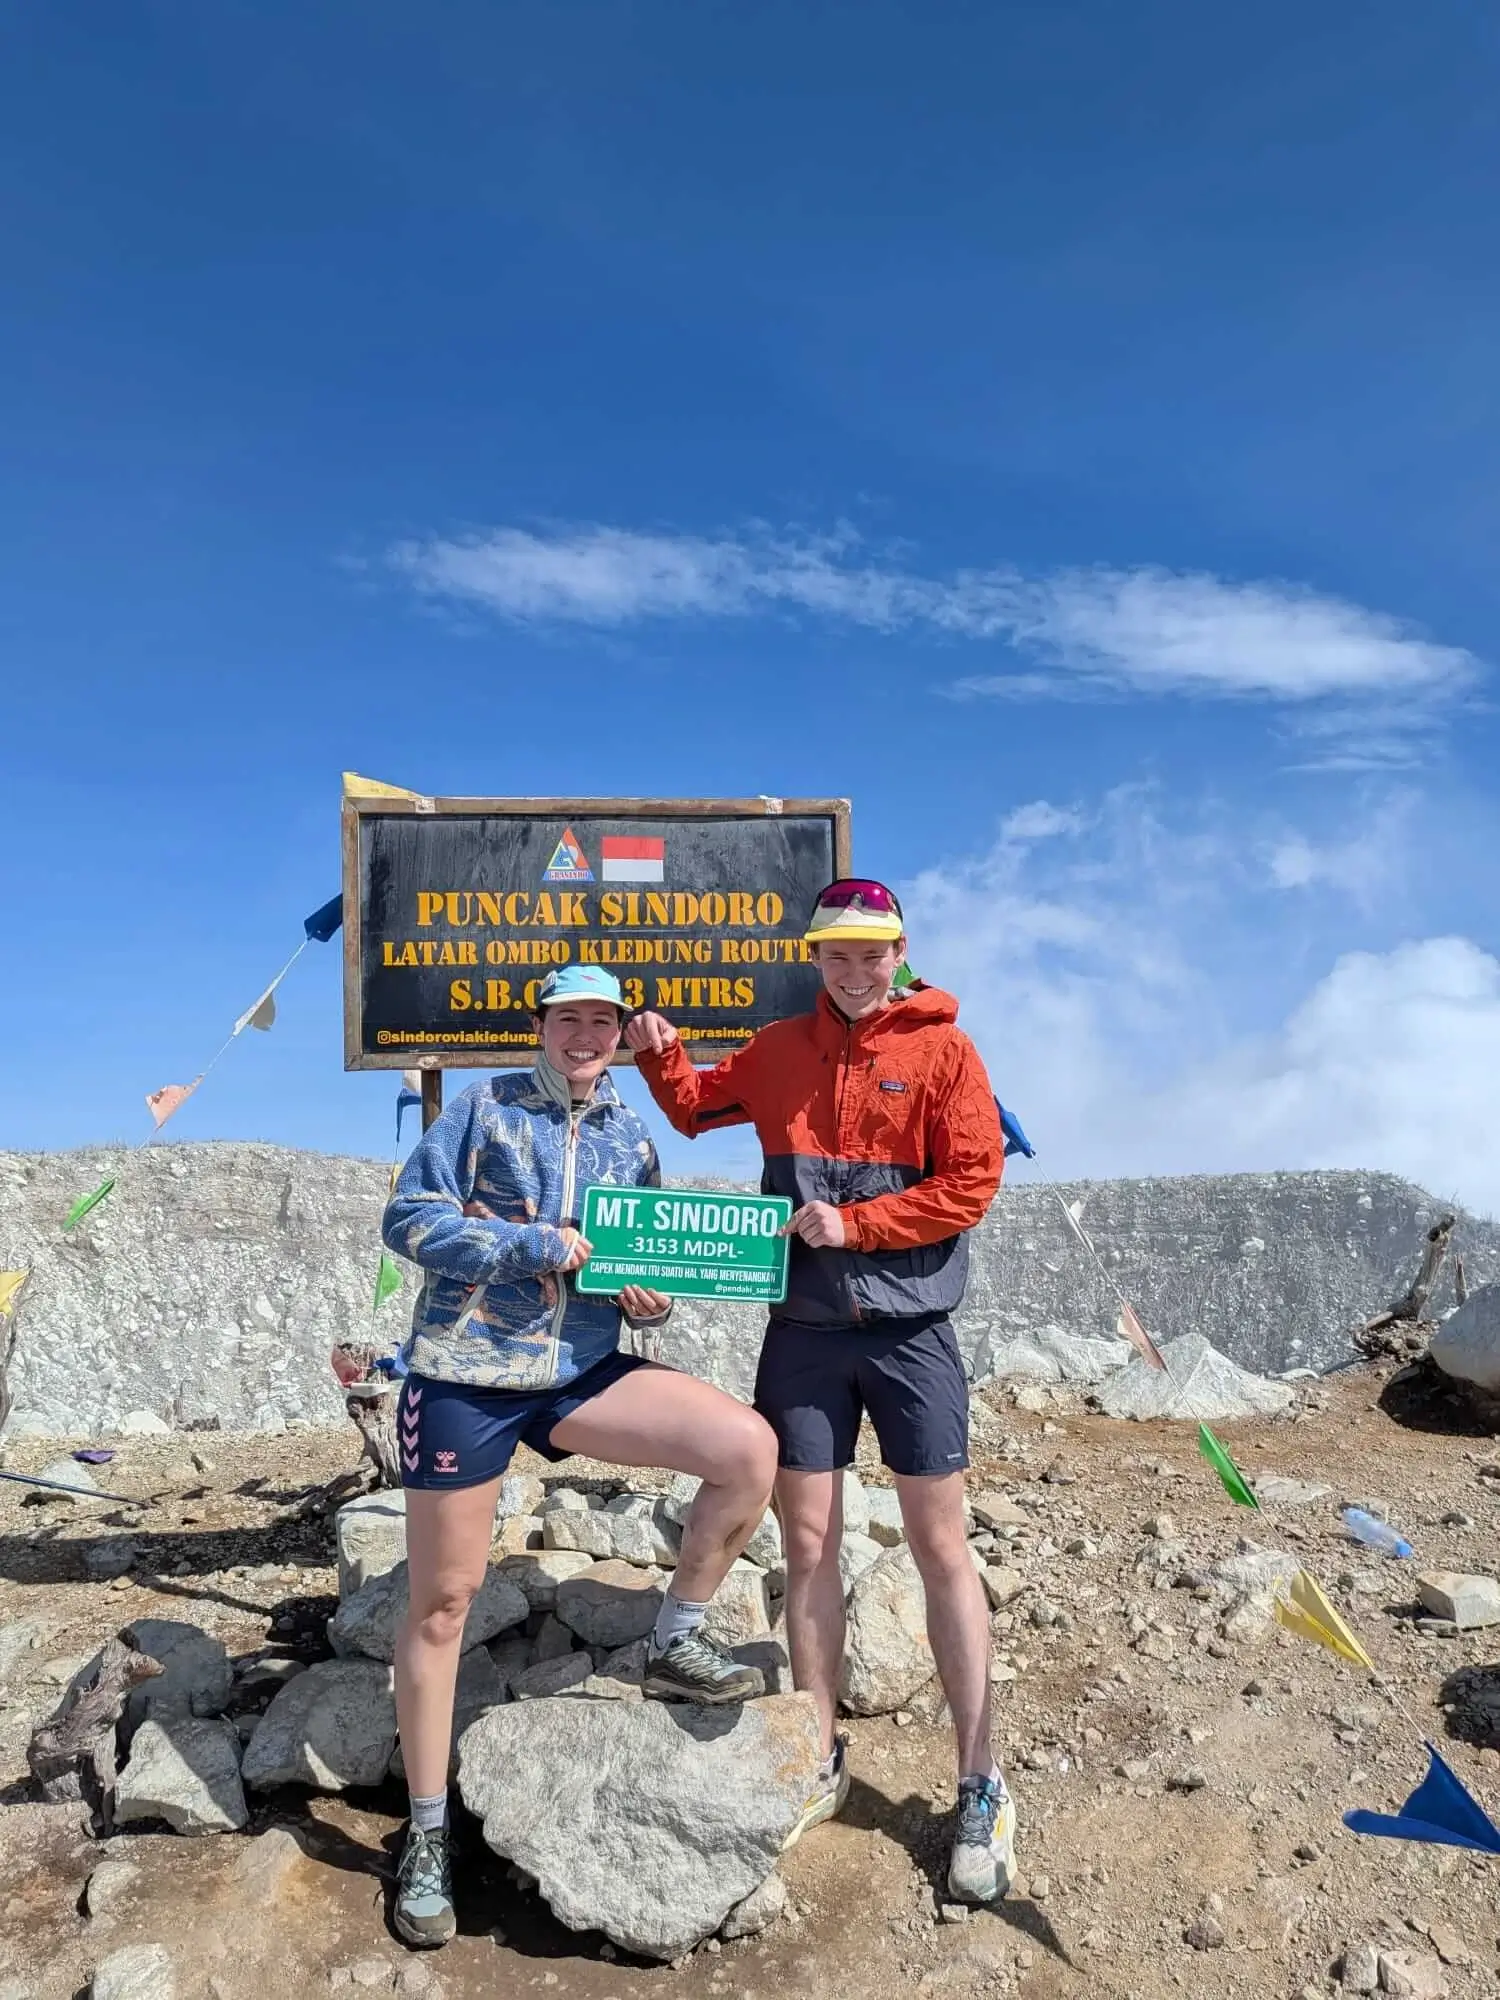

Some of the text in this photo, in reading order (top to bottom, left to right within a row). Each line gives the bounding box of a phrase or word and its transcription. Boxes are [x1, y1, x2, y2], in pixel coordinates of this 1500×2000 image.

[549, 870, 589, 880] GRASINDO
[416, 891, 784, 927] PUNCAK SINDORO
[383, 940, 478, 966] LATAR
[485, 939, 571, 965] OMBO
[579, 939, 712, 964] KLEDUNG
[656, 977, 755, 1008] MTRS
[595, 1196, 779, 1238] MT. SINDORO
[626, 1236, 744, 1260] -3153 MDPL-
[590, 1261, 776, 1283] CAPEK MENDAKI ITU SUATU HAL YANG MENYENANGKAN
